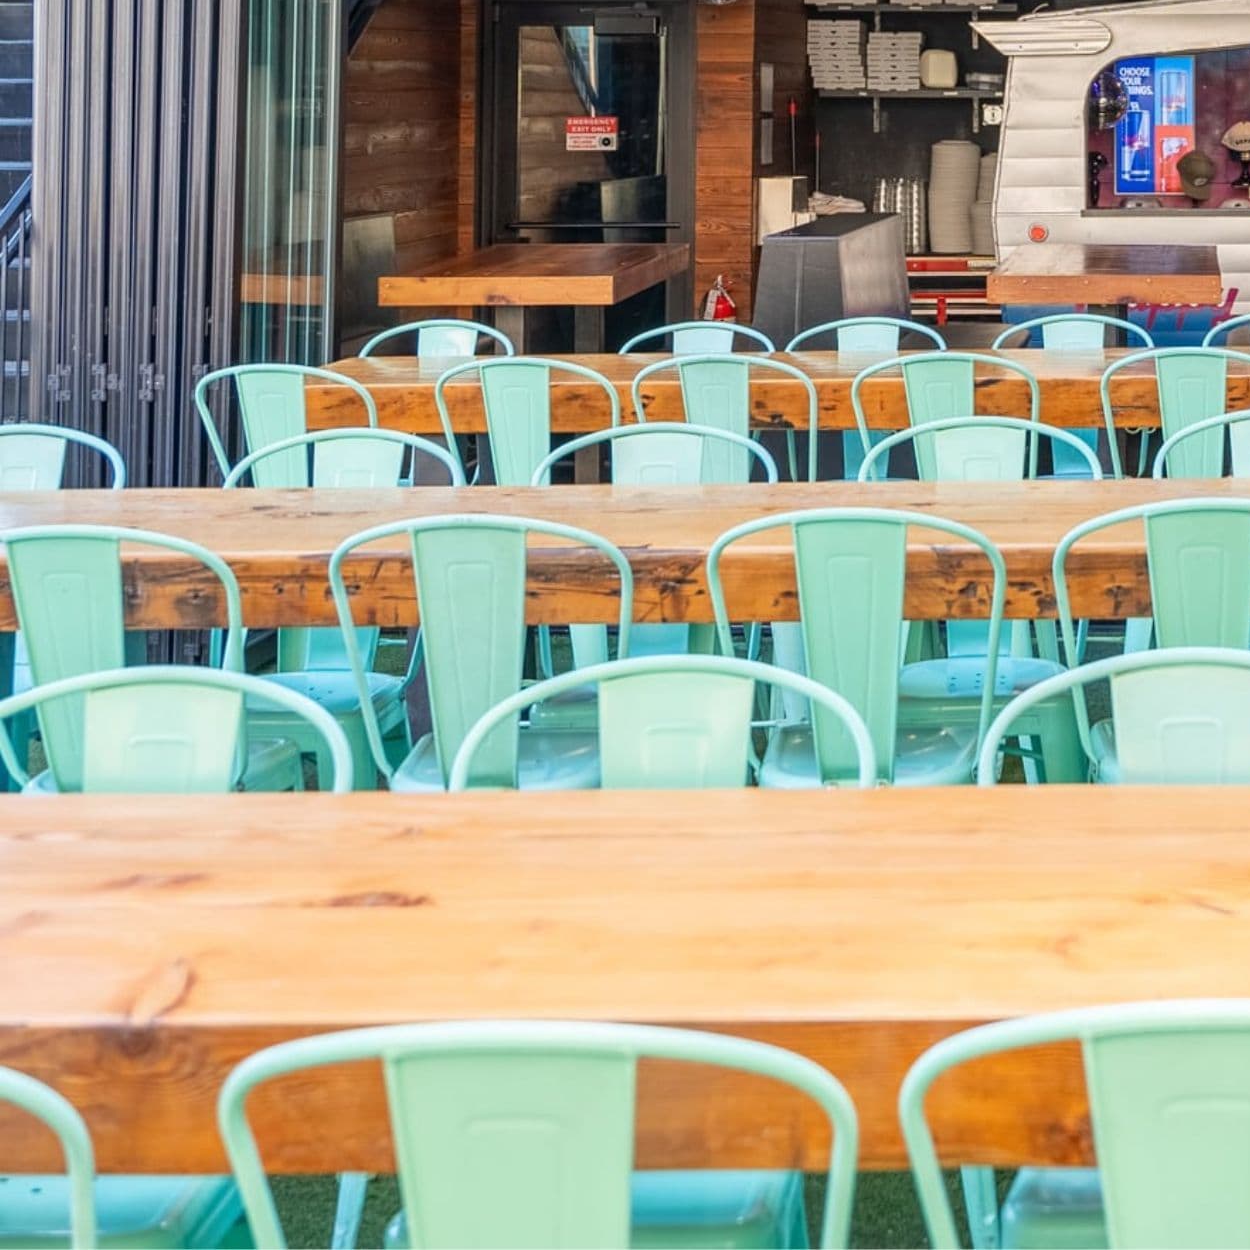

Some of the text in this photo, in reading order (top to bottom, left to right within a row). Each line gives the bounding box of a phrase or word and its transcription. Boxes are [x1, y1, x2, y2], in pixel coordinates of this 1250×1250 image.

[1119, 67, 1150, 77] CHOOSE
[1126, 86, 1153, 96] INGS.
[567, 117, 615, 125] EMERGENCY
